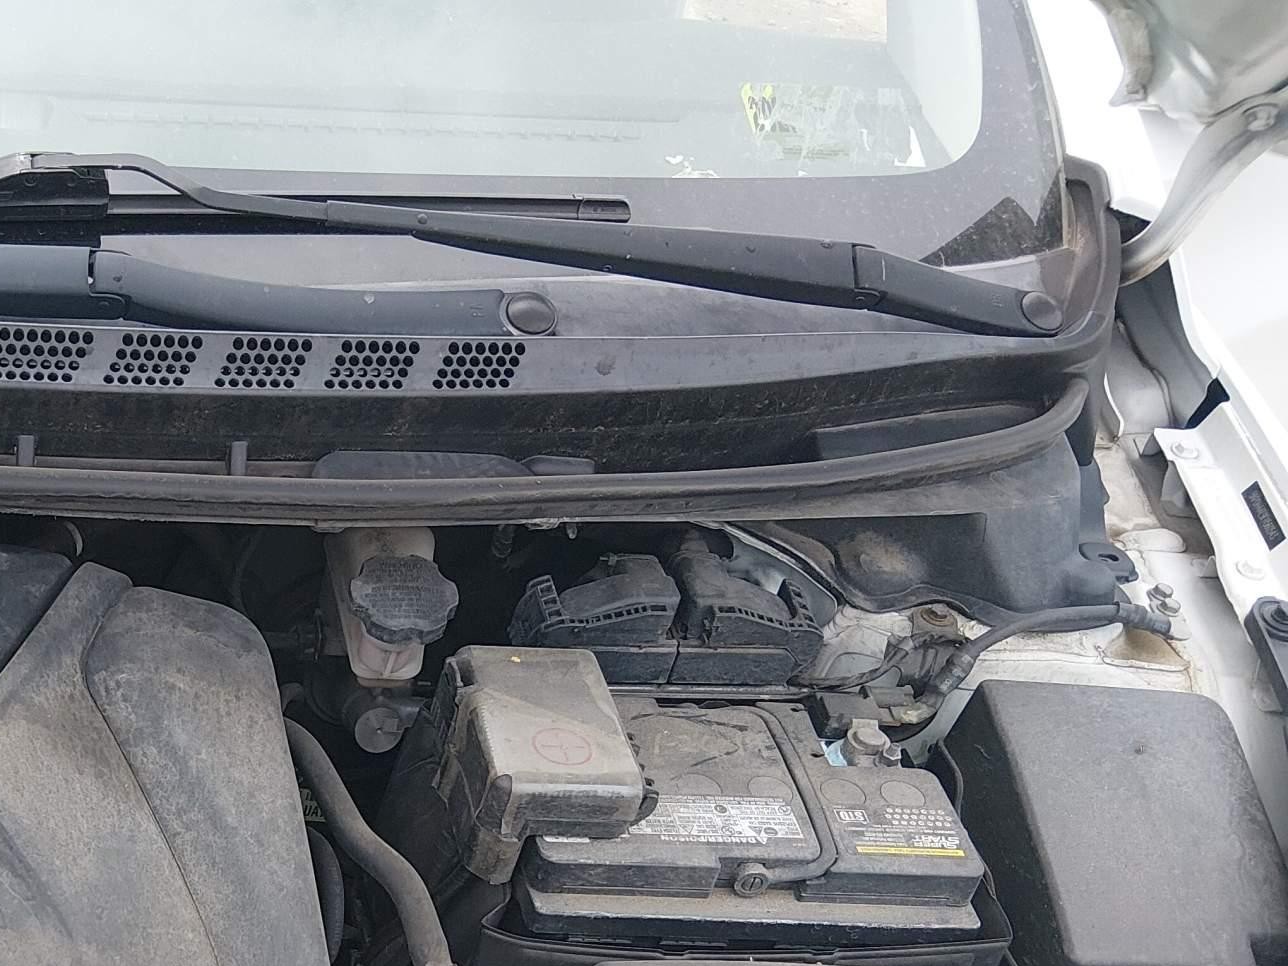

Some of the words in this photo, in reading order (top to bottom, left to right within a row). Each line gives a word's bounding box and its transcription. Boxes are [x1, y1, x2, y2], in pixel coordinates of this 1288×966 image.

[839, 811, 865, 821] STD
[661, 835, 756, 845] DANGER/POISON
[911, 834, 959, 843] START
[913, 841, 958, 849] SUPER
